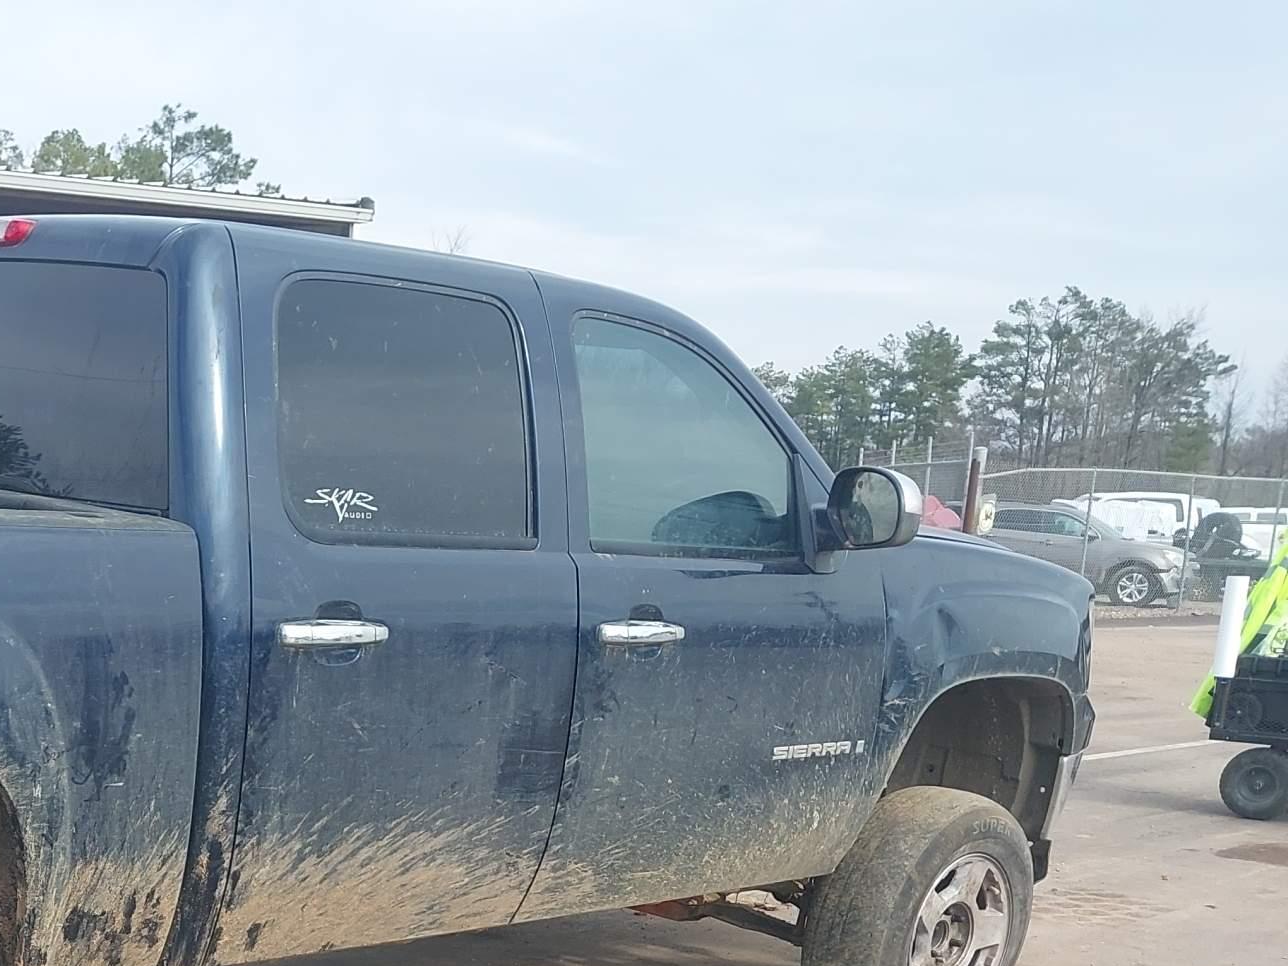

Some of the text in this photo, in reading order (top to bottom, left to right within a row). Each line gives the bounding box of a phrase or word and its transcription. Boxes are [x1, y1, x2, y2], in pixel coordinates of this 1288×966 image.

[304, 487, 378, 523] SKAR
[344, 511, 372, 519] AUDIO
[772, 740, 851, 761] SIERRA
